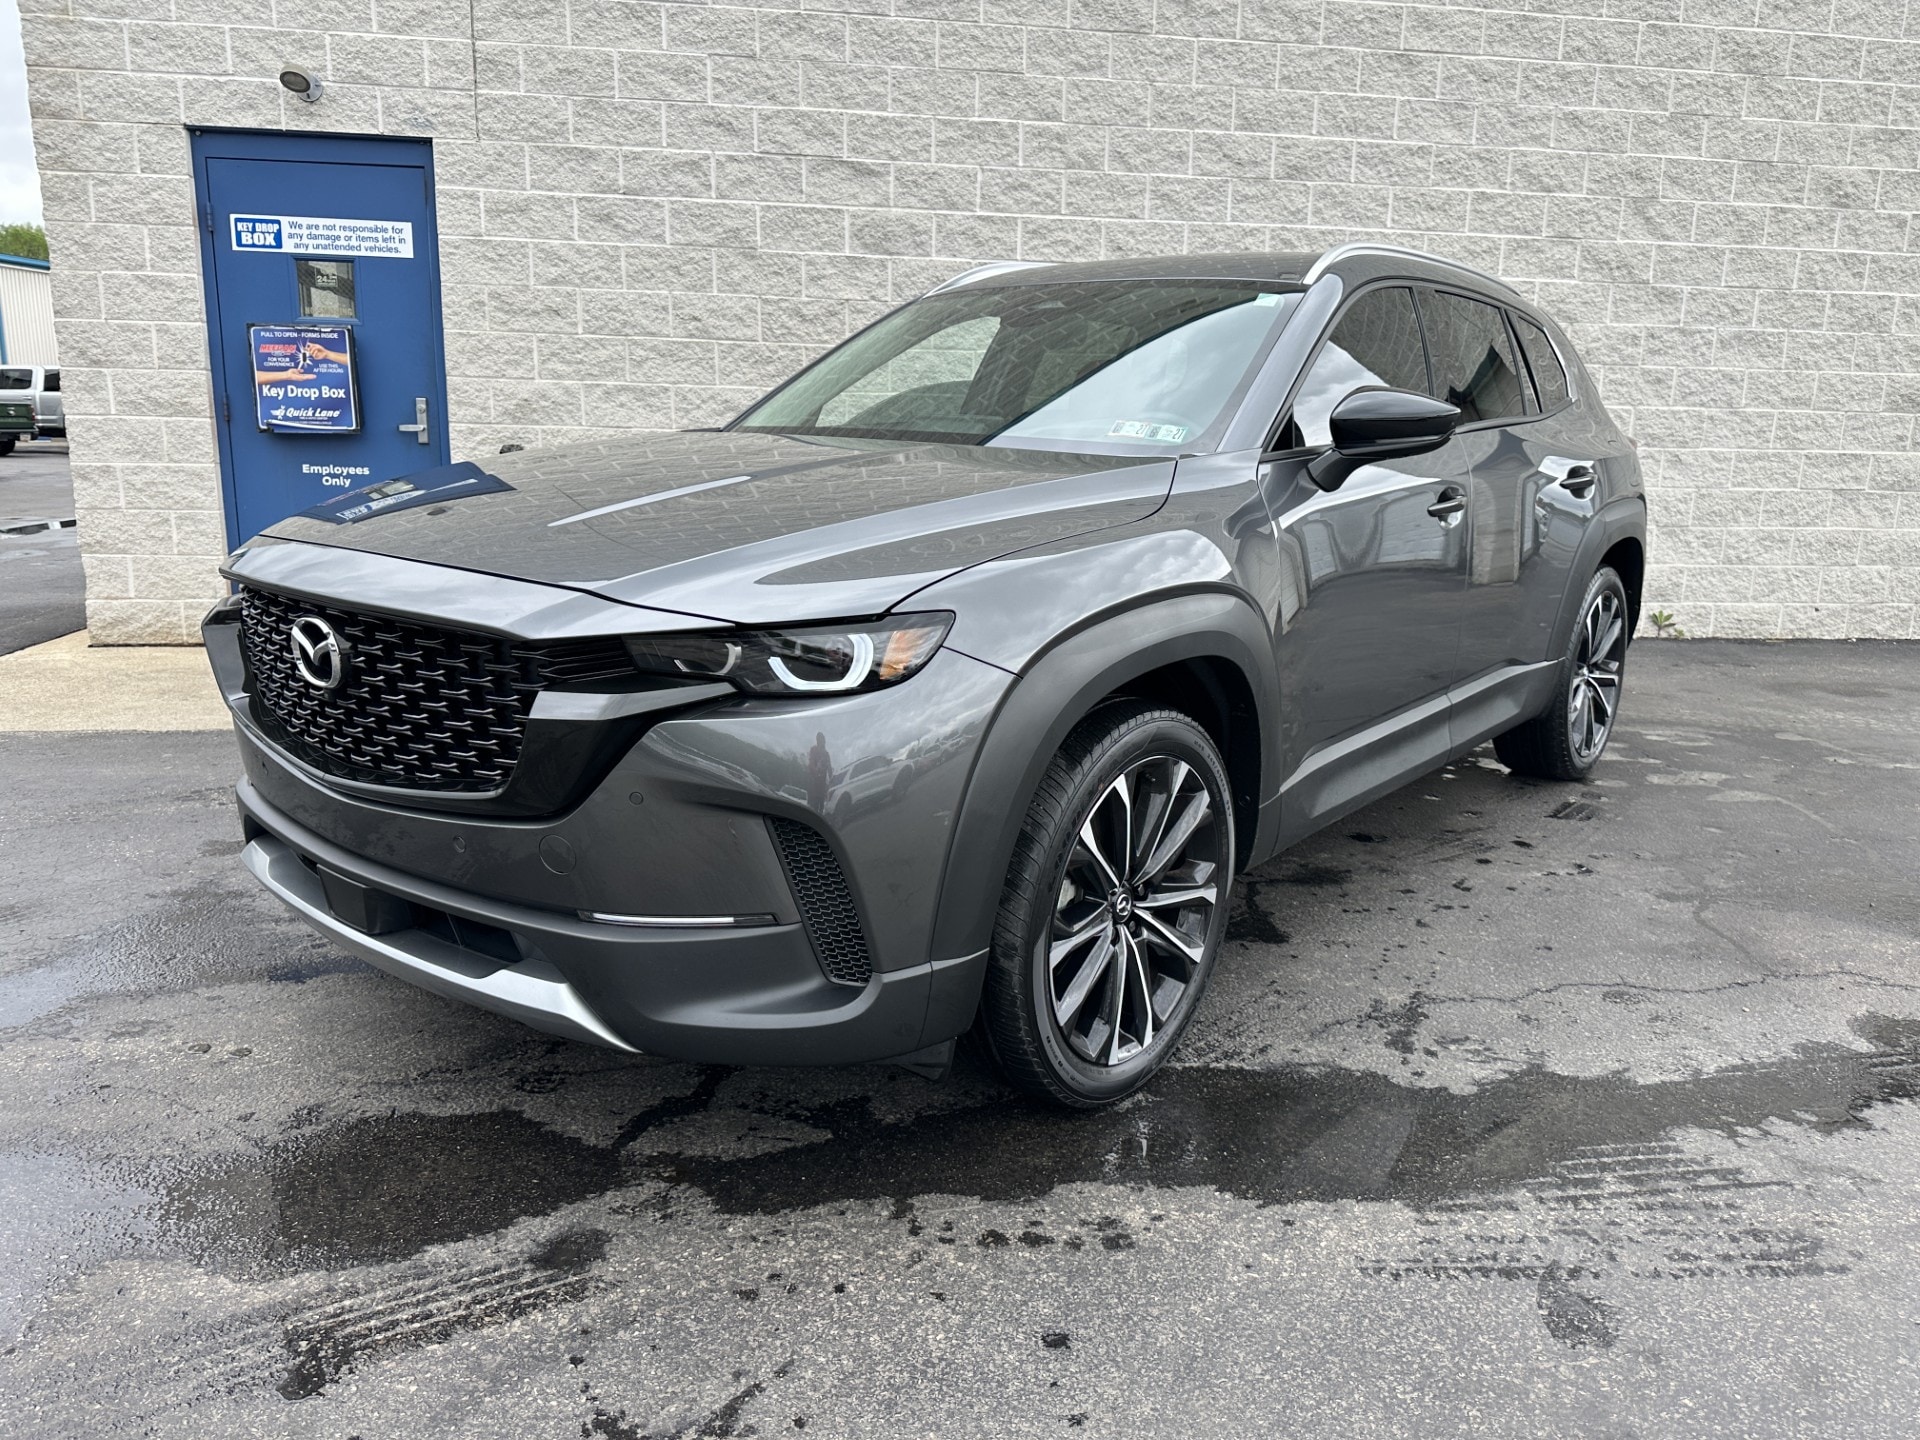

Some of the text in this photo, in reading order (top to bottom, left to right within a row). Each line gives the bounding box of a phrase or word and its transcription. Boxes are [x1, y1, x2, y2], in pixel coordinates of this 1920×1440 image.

[237, 222, 279, 233] KEY DROP
[288, 220, 303, 229] We
[322, 223, 336, 231] not
[339, 224, 389, 234] responsible
[392, 225, 404, 234] for
[241, 232, 276, 246] BOX
[287, 232, 304, 241] any
[307, 231, 342, 243] damage
[355, 233, 380, 243] items
[382, 235, 396, 244] left
[398, 236, 406, 244] in
[294, 242, 402, 253] any unattended vehicles.
[262, 384, 346, 400] Key Drop Box
[286, 407, 341, 417] Quick Lane
[1172, 428, 1185, 440] 27
[302, 463, 370, 476] Employees
[322, 476, 351, 488] Only
